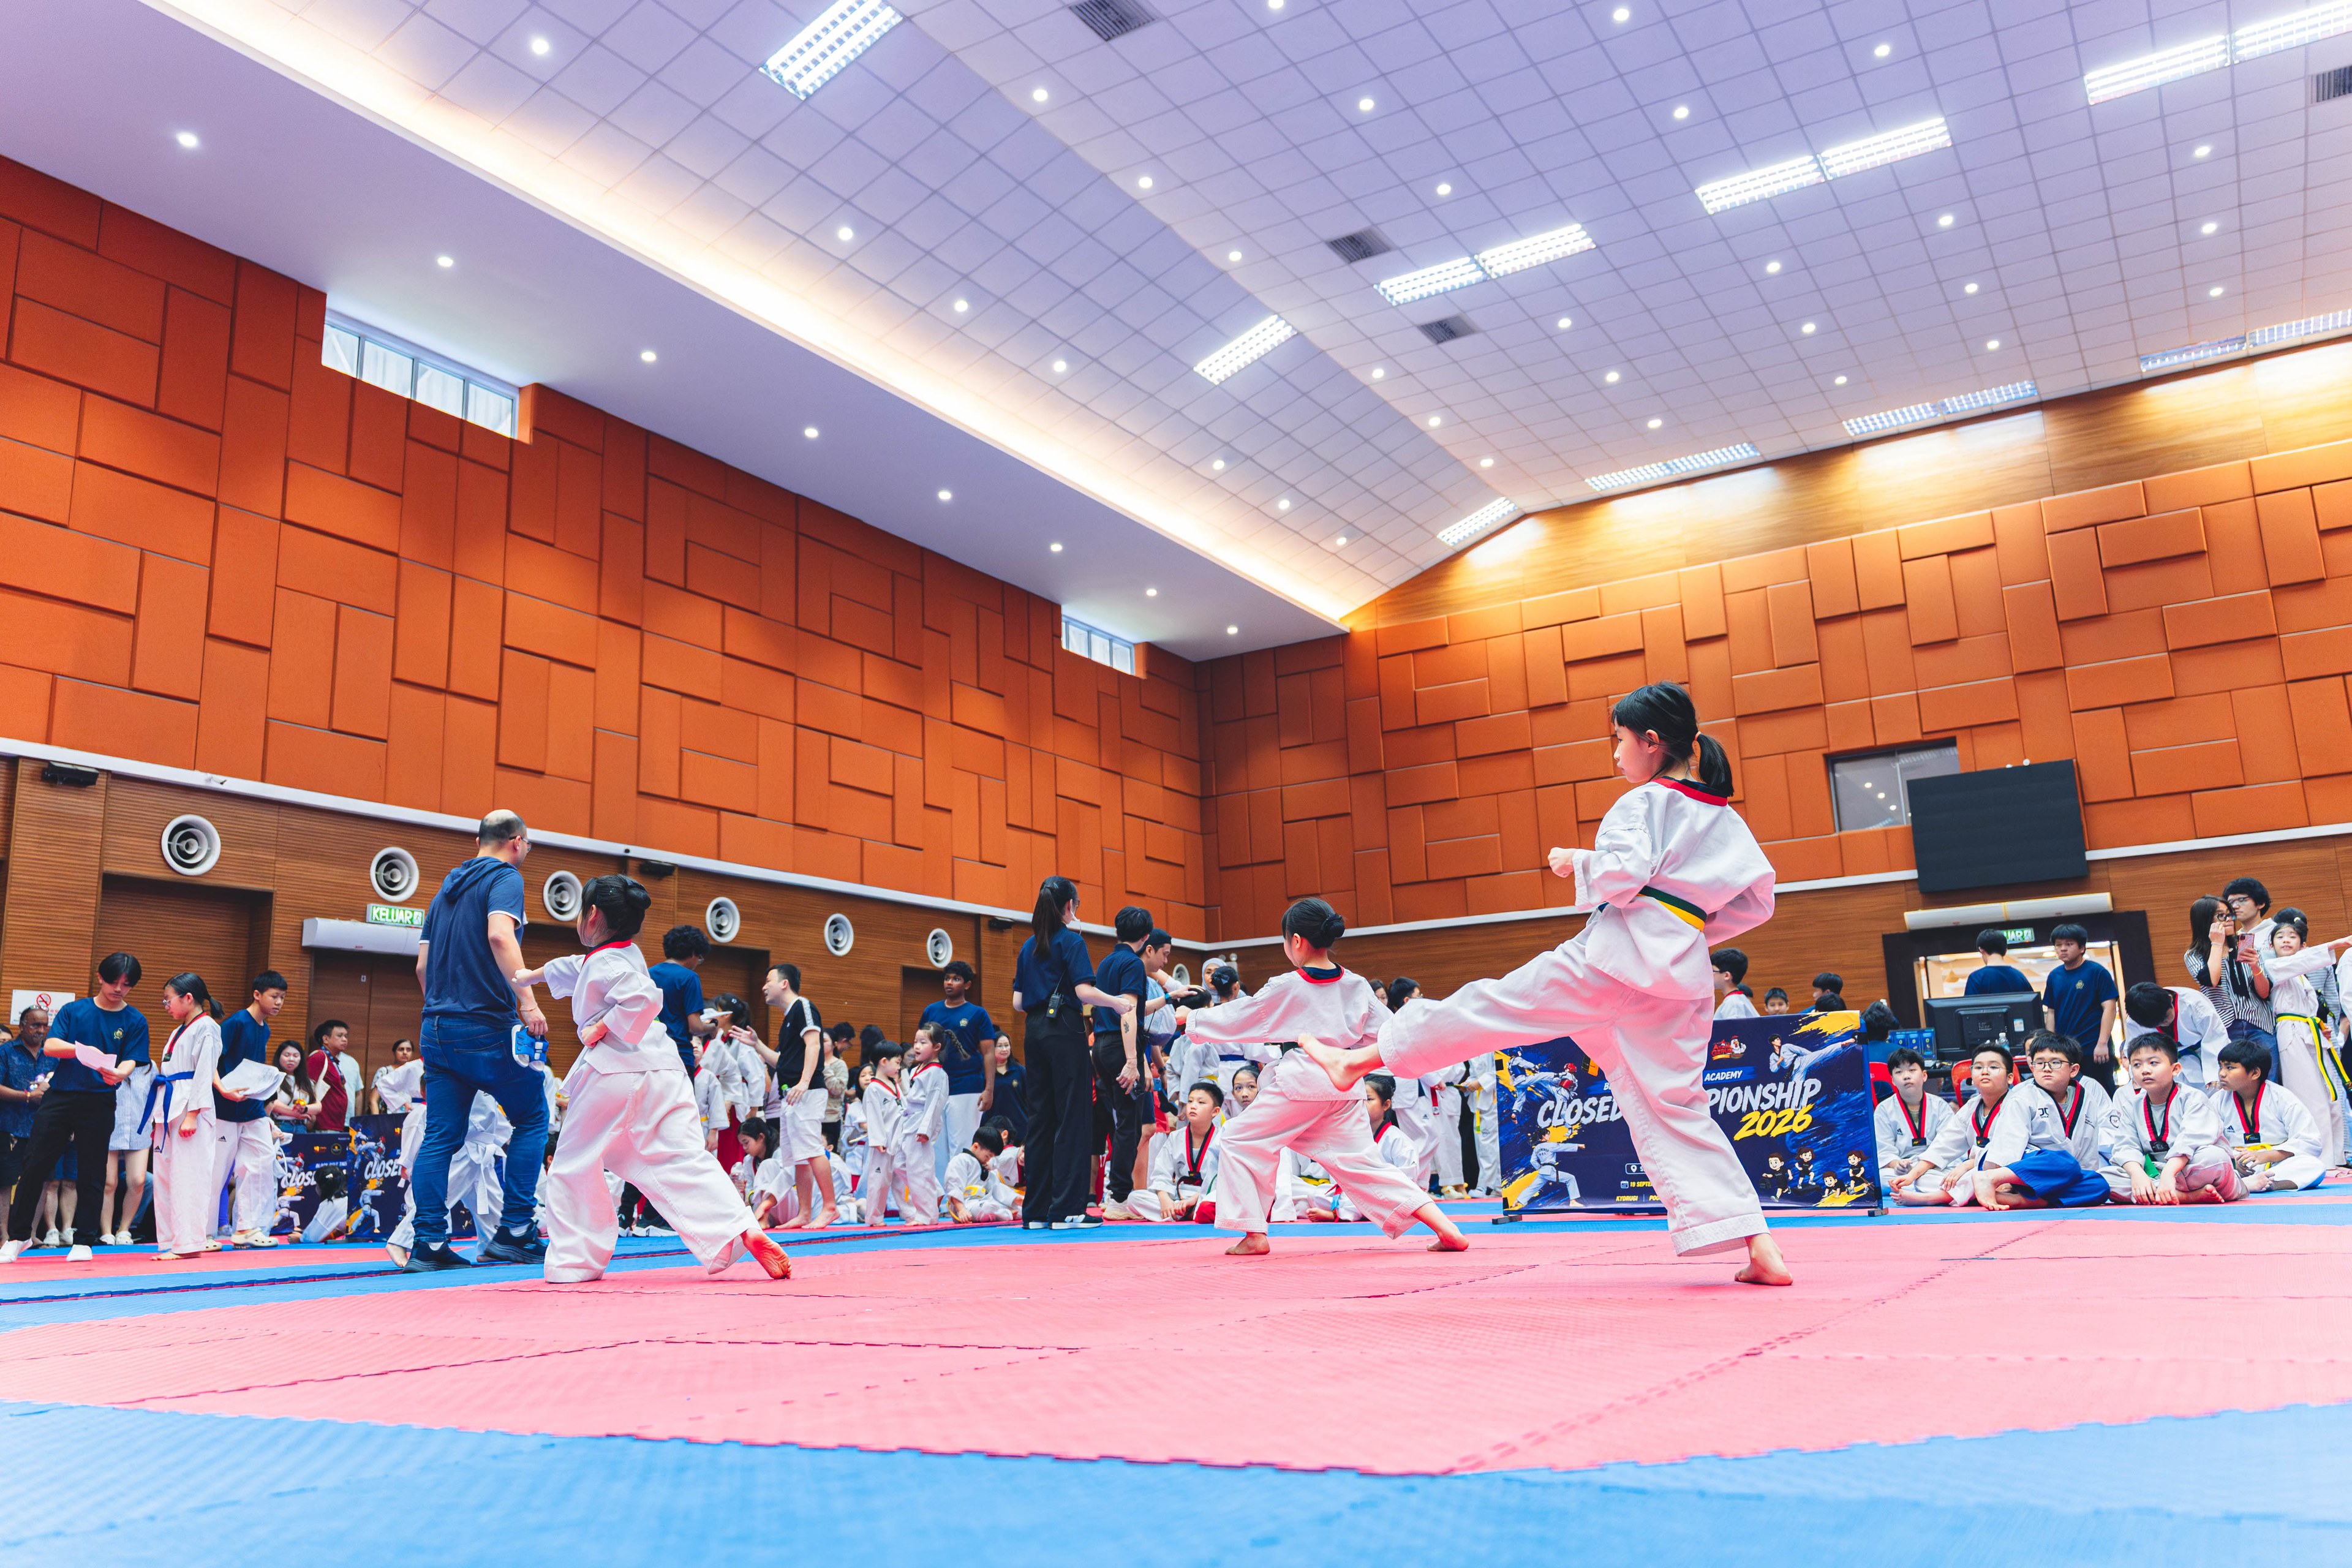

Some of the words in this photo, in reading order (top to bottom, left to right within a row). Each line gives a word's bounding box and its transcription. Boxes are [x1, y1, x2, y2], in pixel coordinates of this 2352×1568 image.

[372, 906, 413, 924] KELUAR
[2003, 930, 2024, 941] UAR
[1704, 1070, 1743, 1082] ACADEMY
[1705, 1078, 1822, 1114] PIONSHIP
[1733, 1103, 1815, 1141] 2026
[364, 1159, 401, 1180] CLOSE
